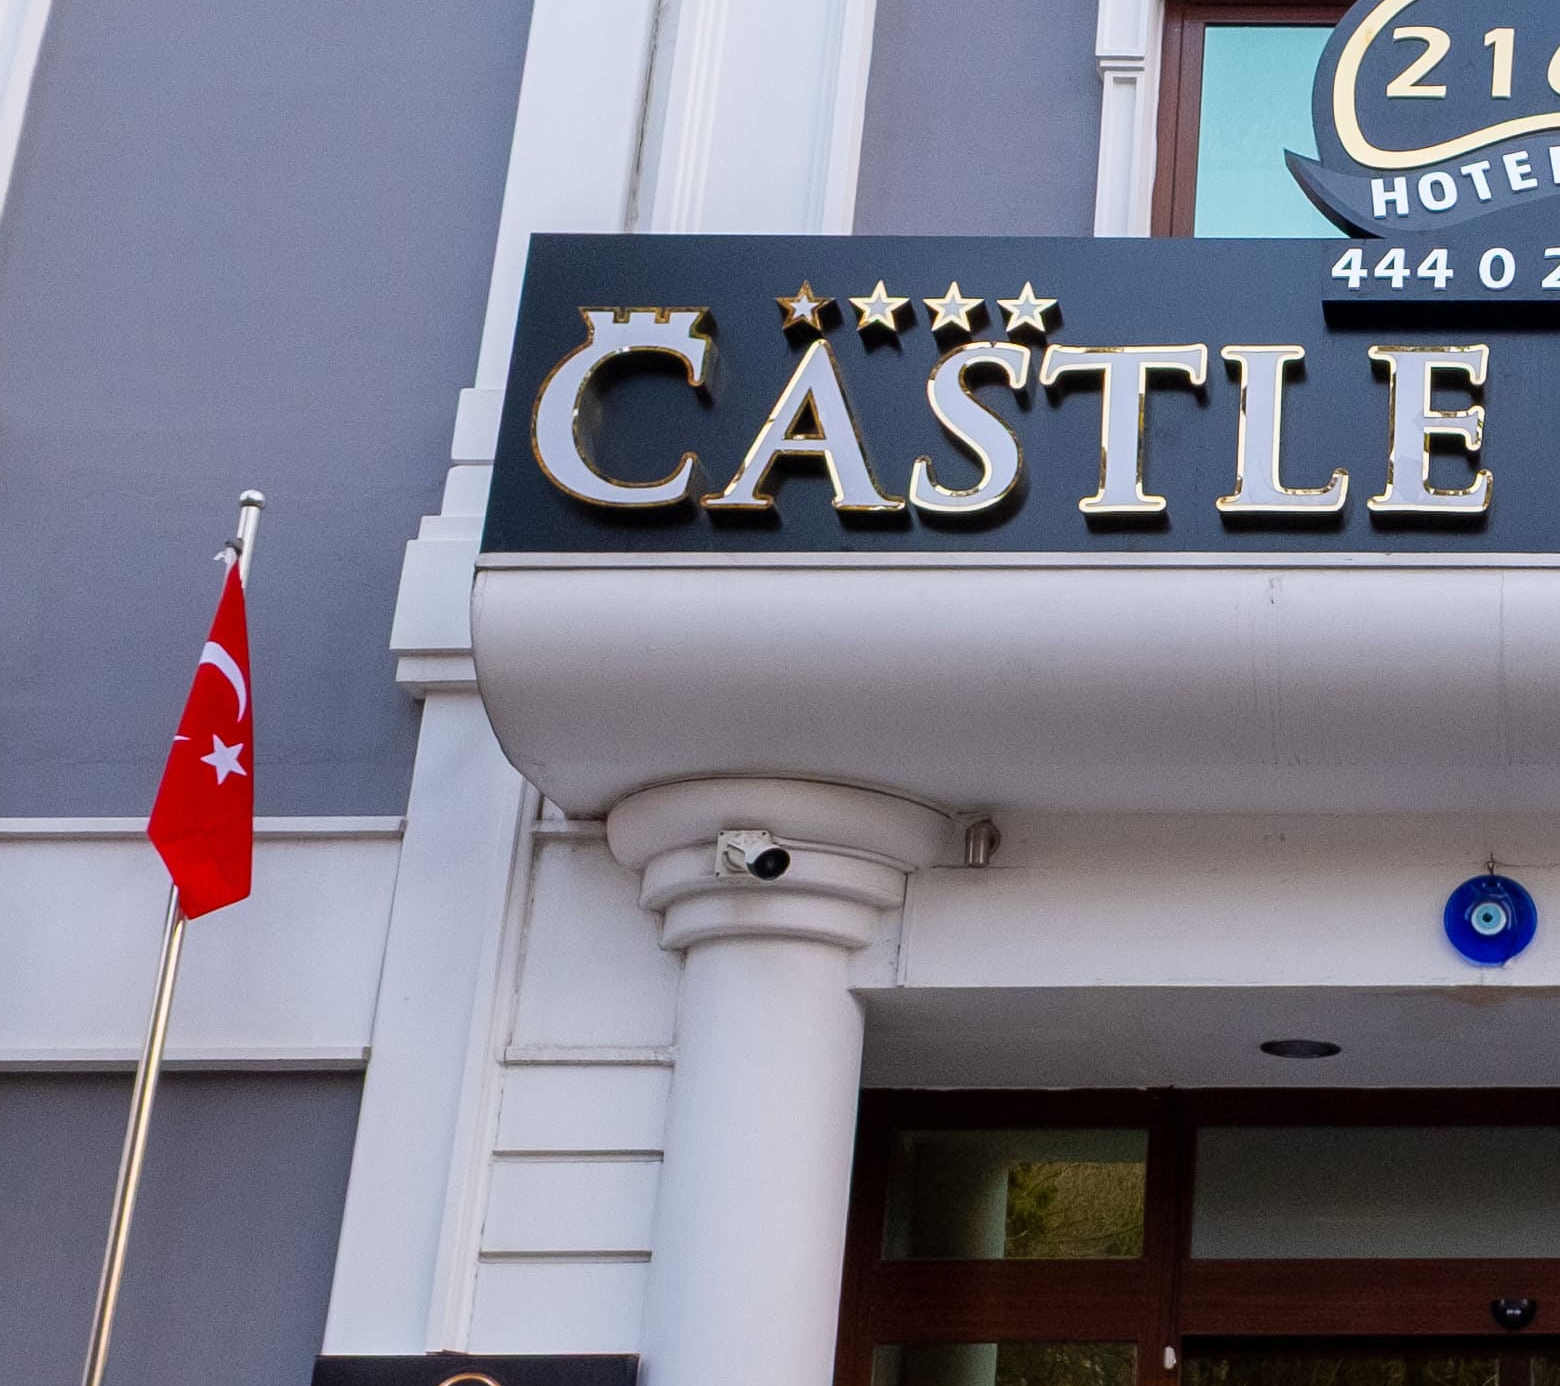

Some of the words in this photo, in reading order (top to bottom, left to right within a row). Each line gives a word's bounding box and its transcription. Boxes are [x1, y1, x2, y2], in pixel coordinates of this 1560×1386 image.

[1331, 247, 1454, 291] 444
[1478, 247, 1516, 291] 0
[530, 305, 1494, 515] CASTLE
